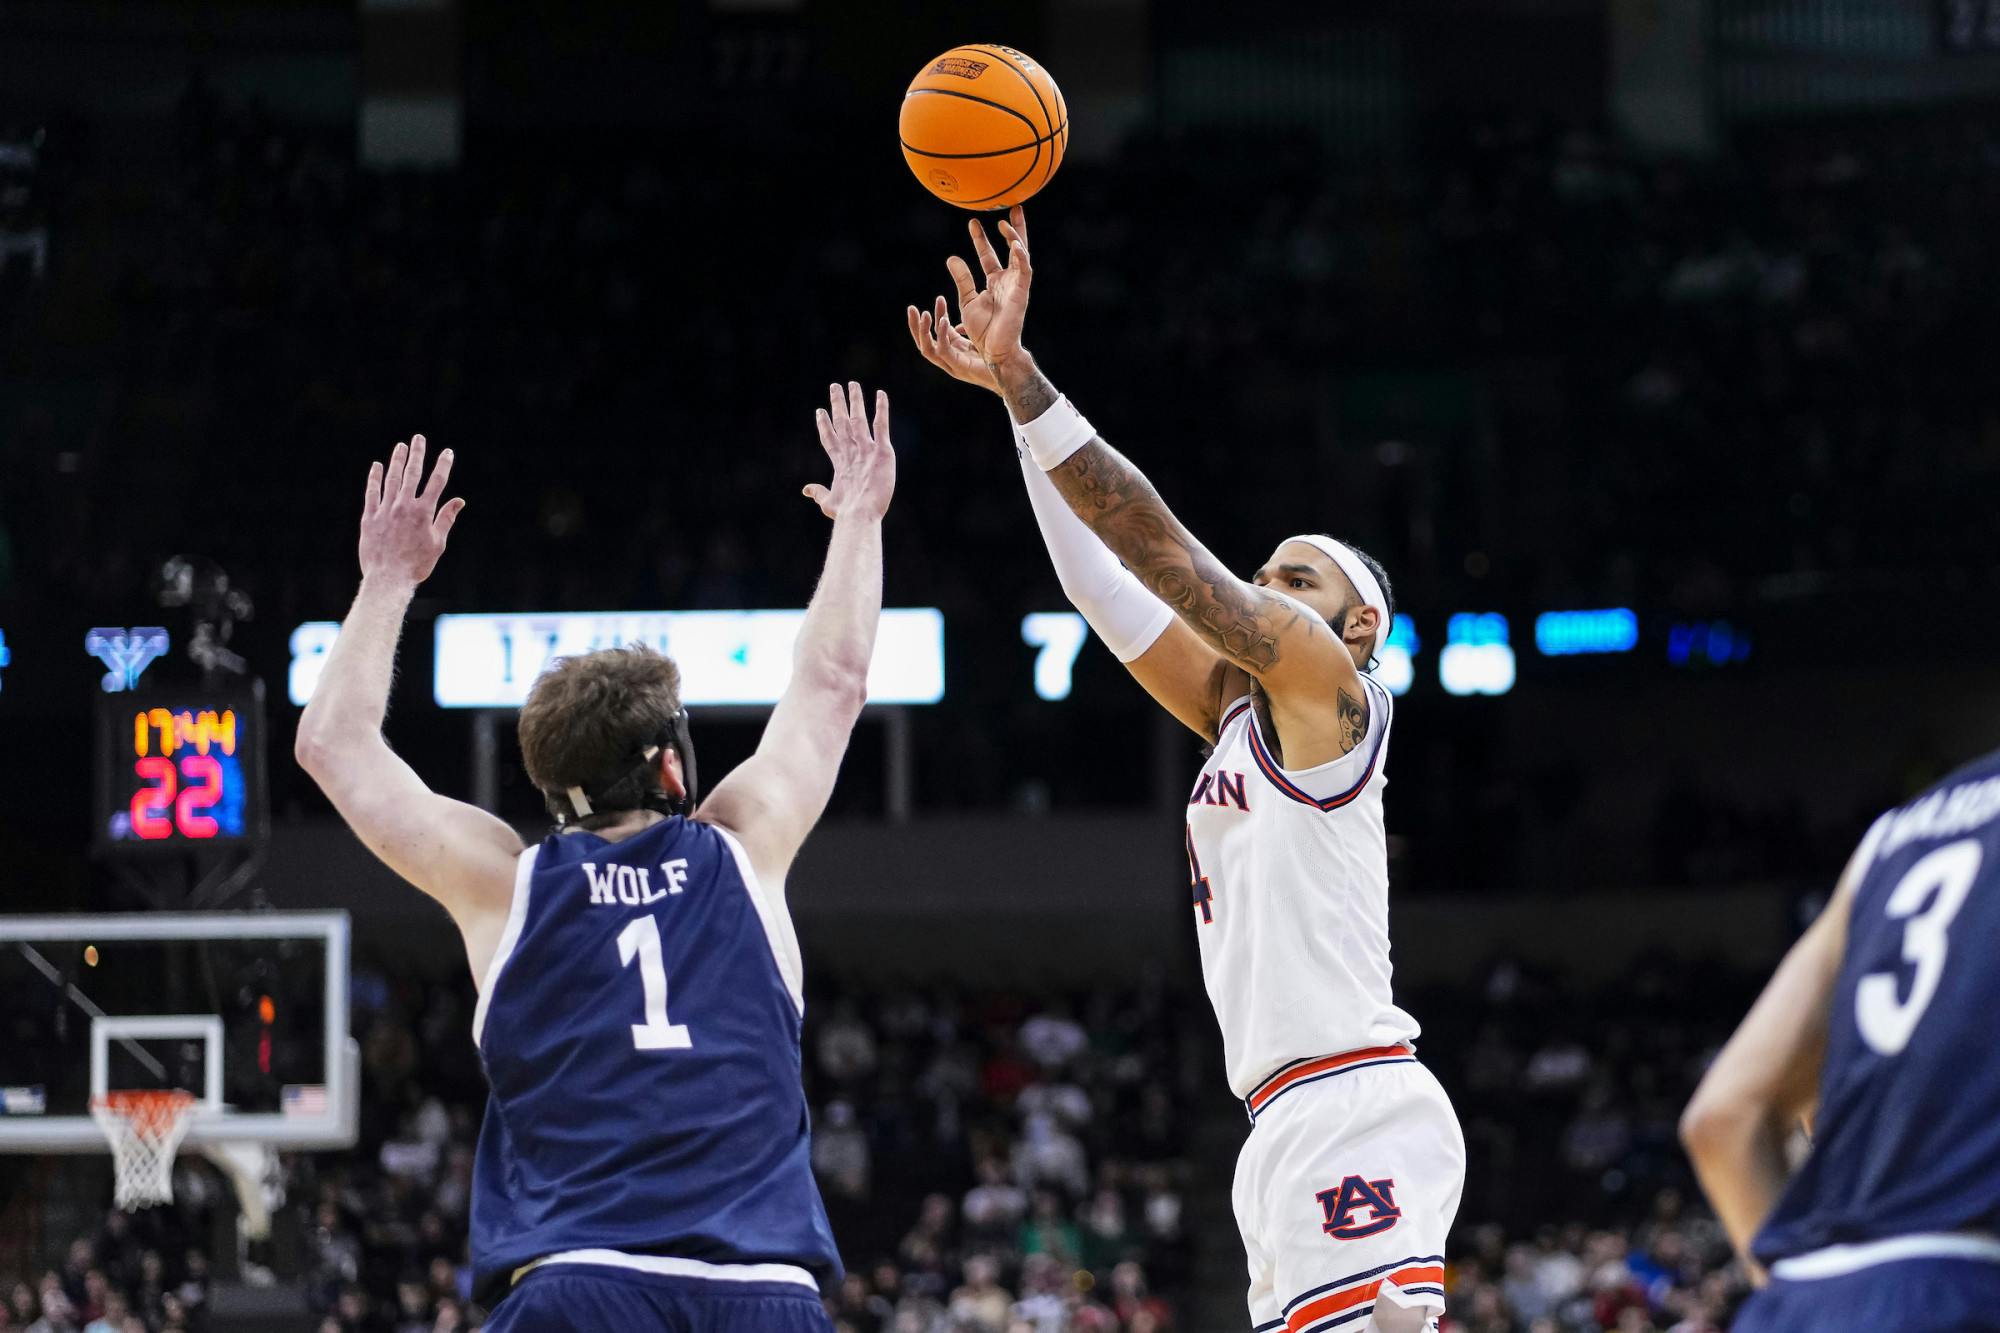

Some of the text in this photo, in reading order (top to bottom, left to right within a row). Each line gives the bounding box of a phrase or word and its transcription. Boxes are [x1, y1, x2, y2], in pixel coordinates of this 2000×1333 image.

[1021, 612, 1086, 700] 7
[130, 757, 223, 839] 22
[581, 857, 689, 906] WOLF
[616, 913, 693, 1049] 1
[1855, 837, 1983, 1057] 3
